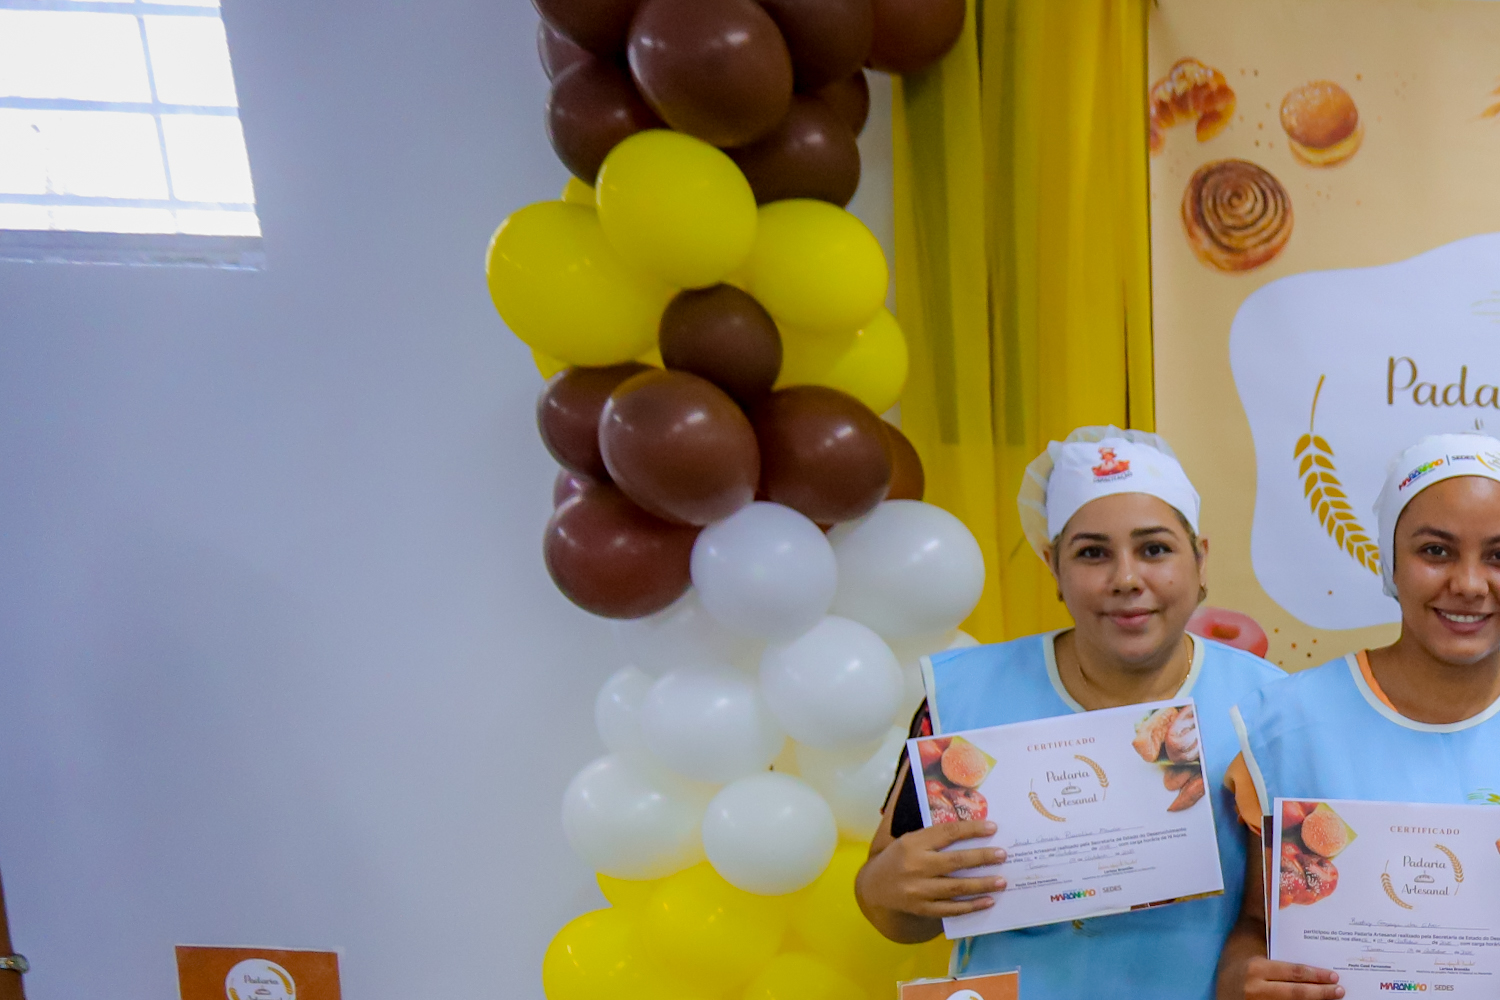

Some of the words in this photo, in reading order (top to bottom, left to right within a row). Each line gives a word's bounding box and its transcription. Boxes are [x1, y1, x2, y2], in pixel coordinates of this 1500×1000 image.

[1027, 737, 1096, 751] CERTIFICADO
[1046, 769, 1090, 783] Padaria
[1051, 793, 1098, 808] Artesanal
[1390, 826, 1460, 835] CERTIFICADO
[1403, 855, 1447, 869] Padaria
[1102, 885, 1122, 893] SEDES
[1402, 884, 1449, 896] Artesanal
